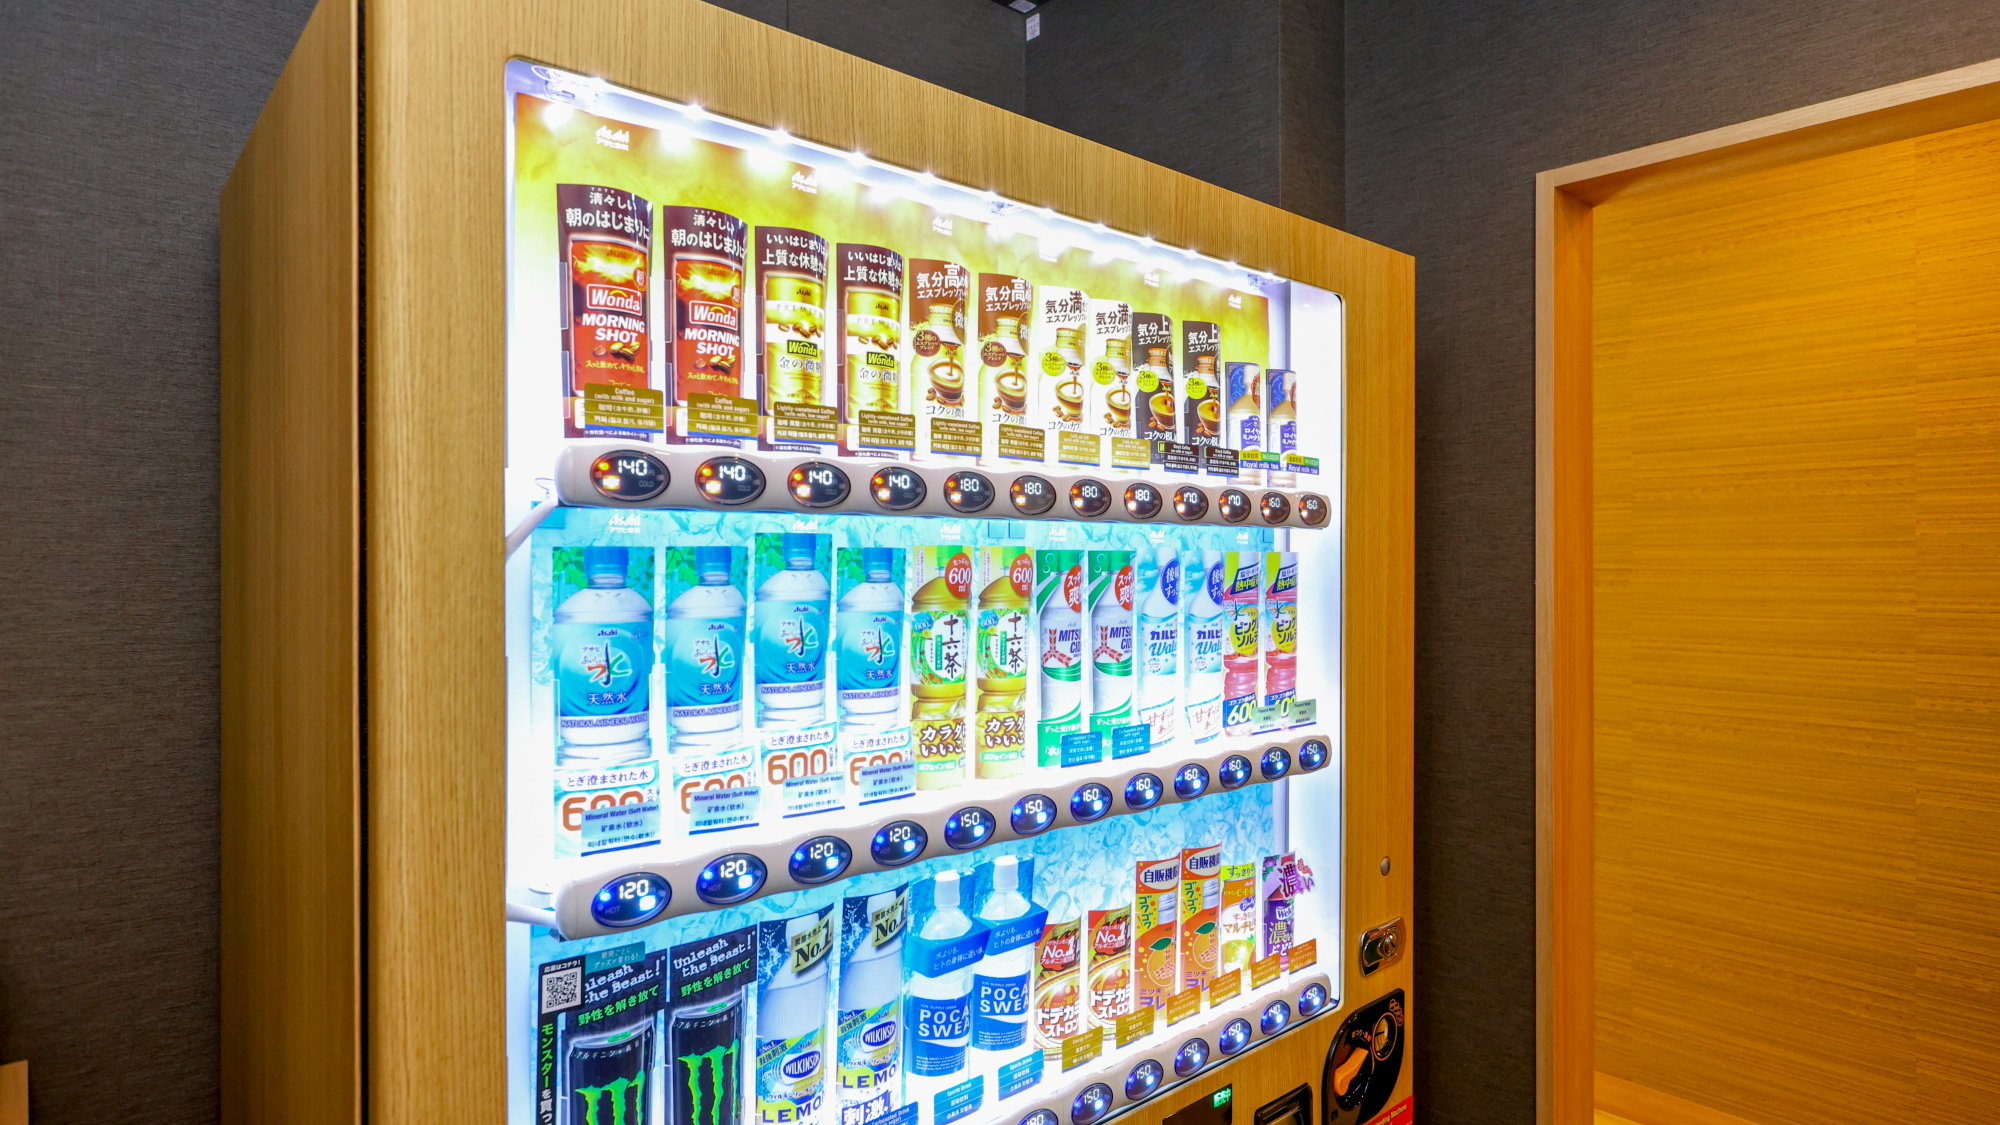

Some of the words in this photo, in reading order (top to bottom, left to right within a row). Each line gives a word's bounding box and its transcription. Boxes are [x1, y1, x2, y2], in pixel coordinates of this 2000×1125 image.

[590, 191, 637, 211] 清々しい
[592, 289, 639, 311] Wonda
[694, 305, 736, 326] Wonda
[582, 313, 645, 333] MORNING
[595, 328, 638, 344] SHOT
[684, 328, 740, 347] MORNING
[696, 342, 734, 356] SHOT
[789, 342, 817, 356] Wonda
[868, 354, 893, 367] Wonda
[618, 459, 647, 476] 140
[719, 465, 746, 480] 140
[809, 471, 832, 485] 140
[889, 475, 910, 488] 140
[960, 478, 979, 492] 180
[1025, 482, 1042, 495] 180
[1082, 486, 1098, 498] 180
[1135, 490, 1150, 501] 180
[1184, 492, 1197, 503] 170
[1228, 495, 1240, 505] 170
[1269, 498, 1280, 507] 160
[1307, 500, 1317, 510] 160
[609, 514, 641, 526] Asahi
[948, 568, 970, 584] 600
[1013, 568, 1032, 584] 600
[942, 614, 962, 678] 十六茶
[1006, 612, 1023, 675] 十六茶
[786, 662, 816, 673] 天然水
[867, 669, 893, 681] 天然水
[701, 682, 732, 695] 天然水
[588, 692, 628, 706] 天然水
[561, 719, 596, 728] NATURAL
[770, 730, 830, 746] とぎ澄まされた水
[852, 734, 905, 748] とぎ澄まされた水
[1307, 744, 1317, 753] 150
[684, 754, 748, 773] とぎ澄まされた水
[1270, 751, 1280, 762] 150
[862, 768, 879, 776] Mineral
[1230, 760, 1241, 770] 160
[567, 769, 648, 787] とぎ澄まされた水
[1185, 768, 1198, 780] 160
[786, 779, 804, 788] Mineral
[1136, 777, 1150, 790] 160
[694, 794, 714, 802] Mineral
[1083, 788, 1098, 802] 160
[586, 811, 609, 821] Mineral
[610, 809, 627, 818] Water
[628, 808, 642, 816] (Soft
[644, 805, 659, 813] Water)
[1025, 800, 1042, 814] 150
[961, 812, 979, 827] 150
[889, 827, 910, 842] 120
[810, 843, 833, 859] 120
[720, 860, 747, 878] 120
[619, 879, 649, 900] 120
[1184, 882, 1197, 914] ゴクゴク
[1139, 896, 1152, 929] ゴクゴク
[673, 938, 728, 969] Unleash
[682, 962, 707, 977] the
[710, 931, 752, 962] Beast!
[585, 964, 633, 991] nleash
[612, 958, 661, 994] Beast!
[681, 958, 750, 997] 野性を解き放て
[981, 984, 1028, 1000] POCA
[1306, 988, 1317, 999] 150
[578, 985, 659, 1026] 野性を解き放て
[980, 995, 1028, 1013] SWEA
[919, 1005, 971, 1023] POCA
[865, 1021, 896, 1045] WILKINSON
[1228, 1023, 1240, 1036] 150
[1185, 1044, 1197, 1056] 150
[785, 1051, 820, 1076] WILKINSON
[1136, 1065, 1151, 1079] 150
[1083, 1089, 1099, 1103] 150
